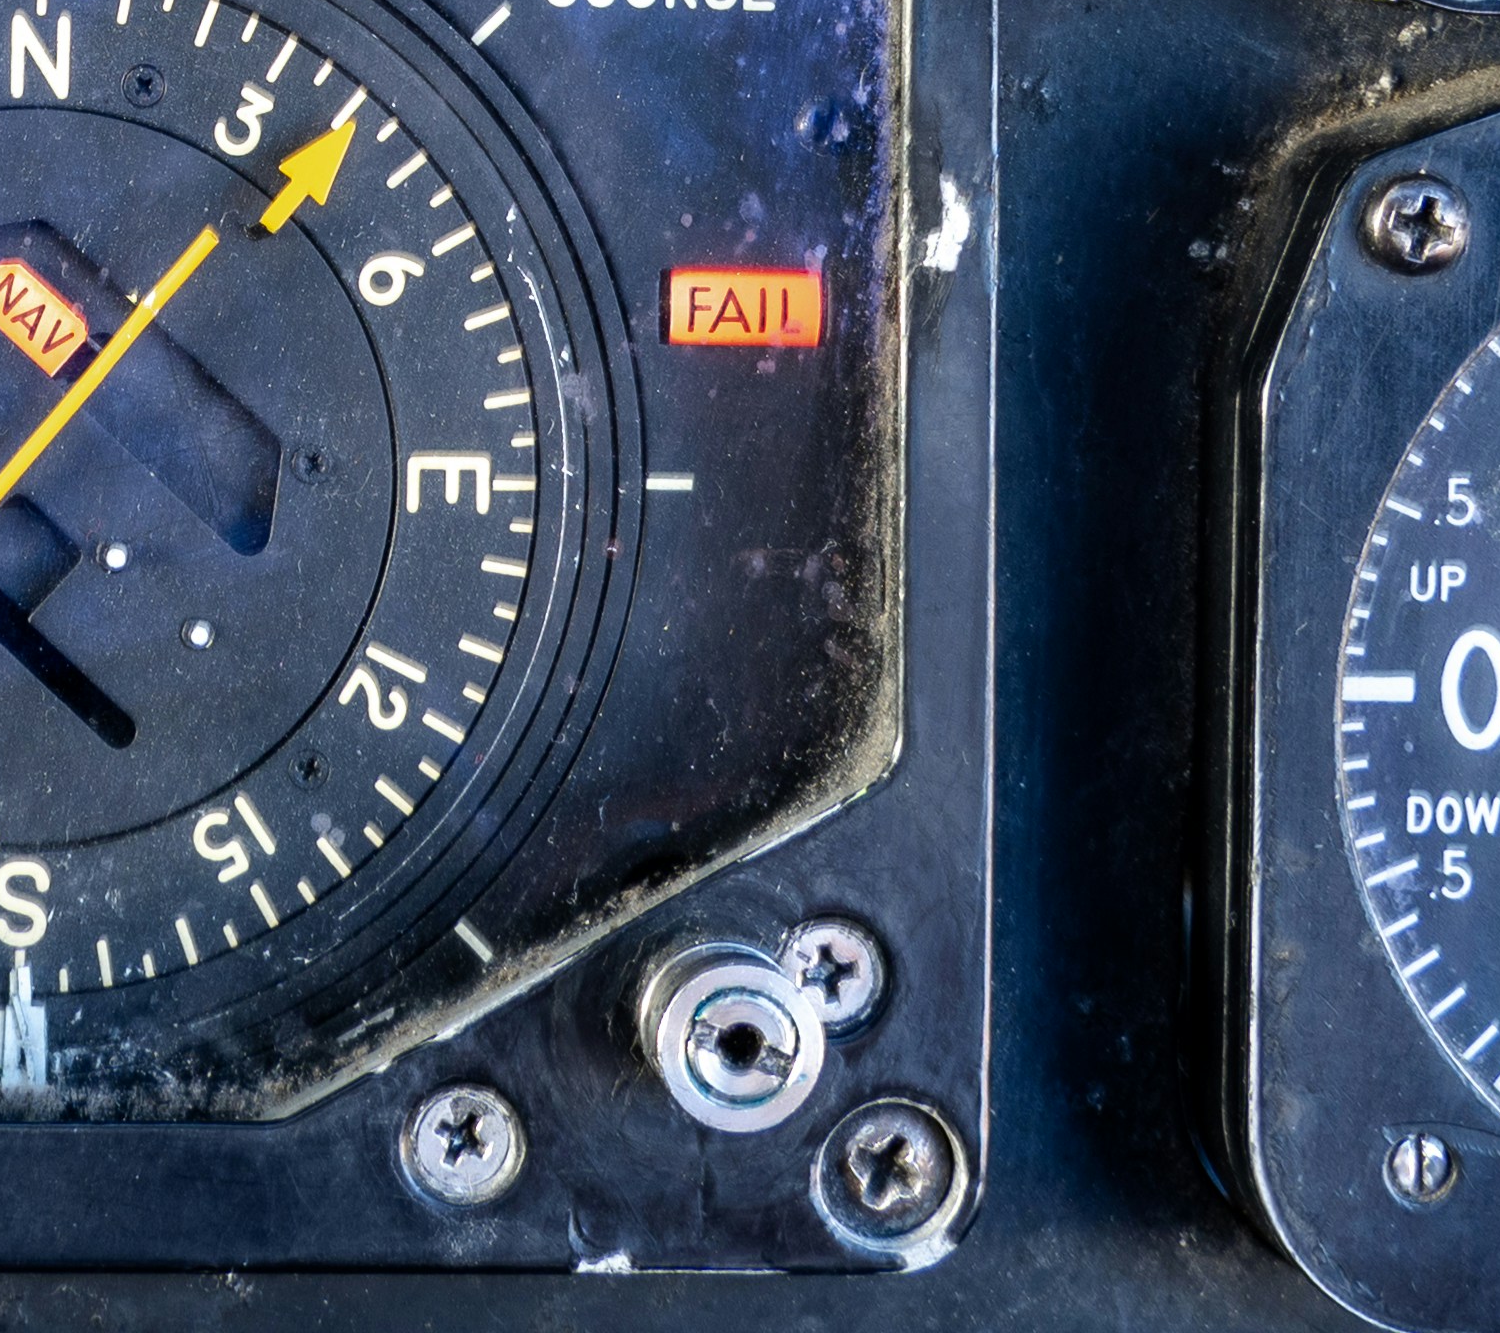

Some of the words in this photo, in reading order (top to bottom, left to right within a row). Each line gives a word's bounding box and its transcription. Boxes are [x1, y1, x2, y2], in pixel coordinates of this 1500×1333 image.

[11, 11, 71, 99] N
[214, 85, 274, 156] 3
[687, 286, 801, 333] FAIL
[406, 452, 492, 514] E
[1409, 563, 1467, 602] UP
[339, 641, 428, 730] 12
[193, 793, 276, 883] 15
